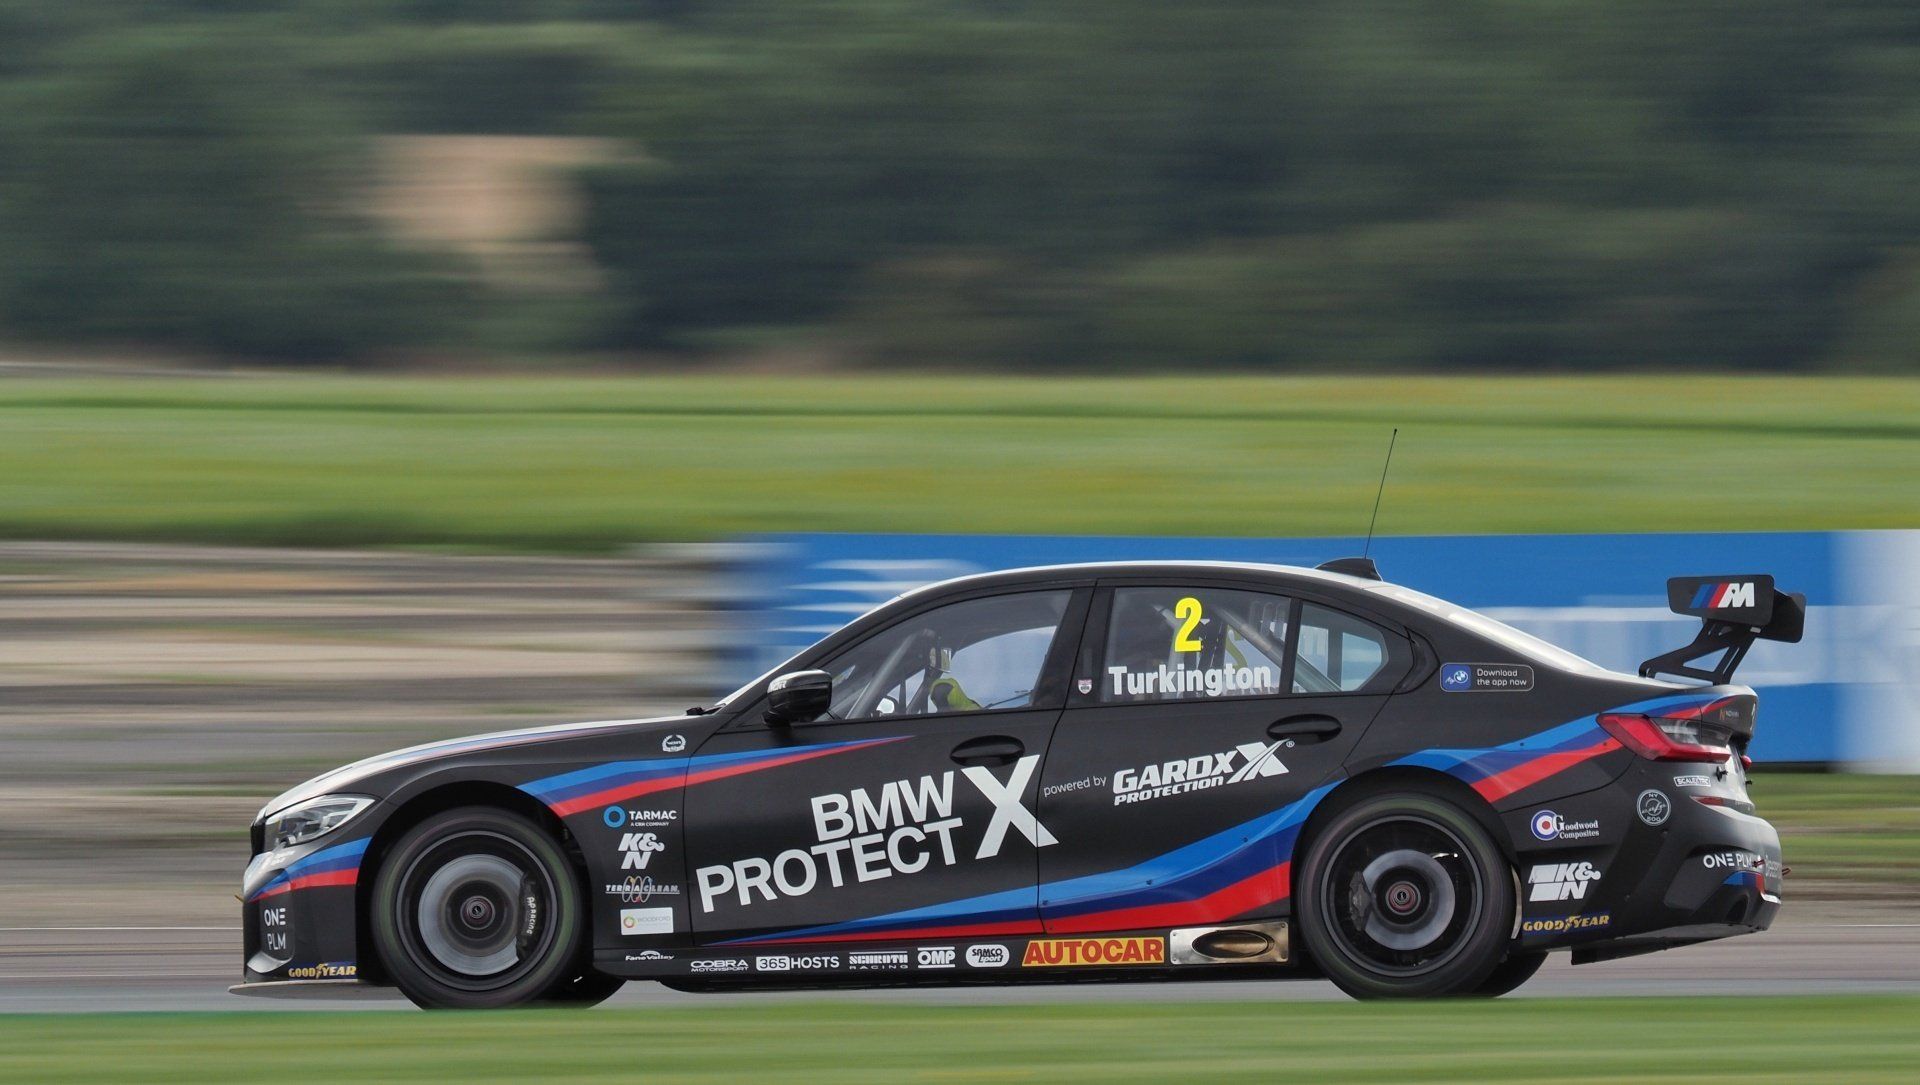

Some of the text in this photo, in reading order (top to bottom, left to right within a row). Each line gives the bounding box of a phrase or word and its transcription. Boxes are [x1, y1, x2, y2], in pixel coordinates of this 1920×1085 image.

[1718, 582, 1755, 608] M
[1174, 597, 1203, 652] 2
[1108, 663, 1272, 697] Turkington
[1477, 668, 1518, 677] Download
[1043, 775, 1107, 797] powered by
[1114, 776, 1225, 806] PROTECTION
[628, 810, 678, 820] TARMAC
[811, 771, 954, 842] BMW
[961, 754, 1060, 860] X
[1552, 815, 1599, 832] Goodwood
[1559, 830, 1600, 839] Composites
[696, 817, 963, 913] PROTECT
[1703, 853, 1734, 868] ONE
[264, 908, 286, 926] ONE
[1523, 915, 1610, 932] GOODYEAR
[267, 933, 286, 950] PLM
[849, 954, 908, 965] SCHROTH
[918, 951, 956, 965] OMP
[971, 948, 1003, 957] SAMCO
[979, 954, 1003, 963] sport
[1024, 939, 1163, 965] AUTOCAR
[288, 963, 357, 979] GOODYEAR
[690, 959, 748, 968] COBRA
